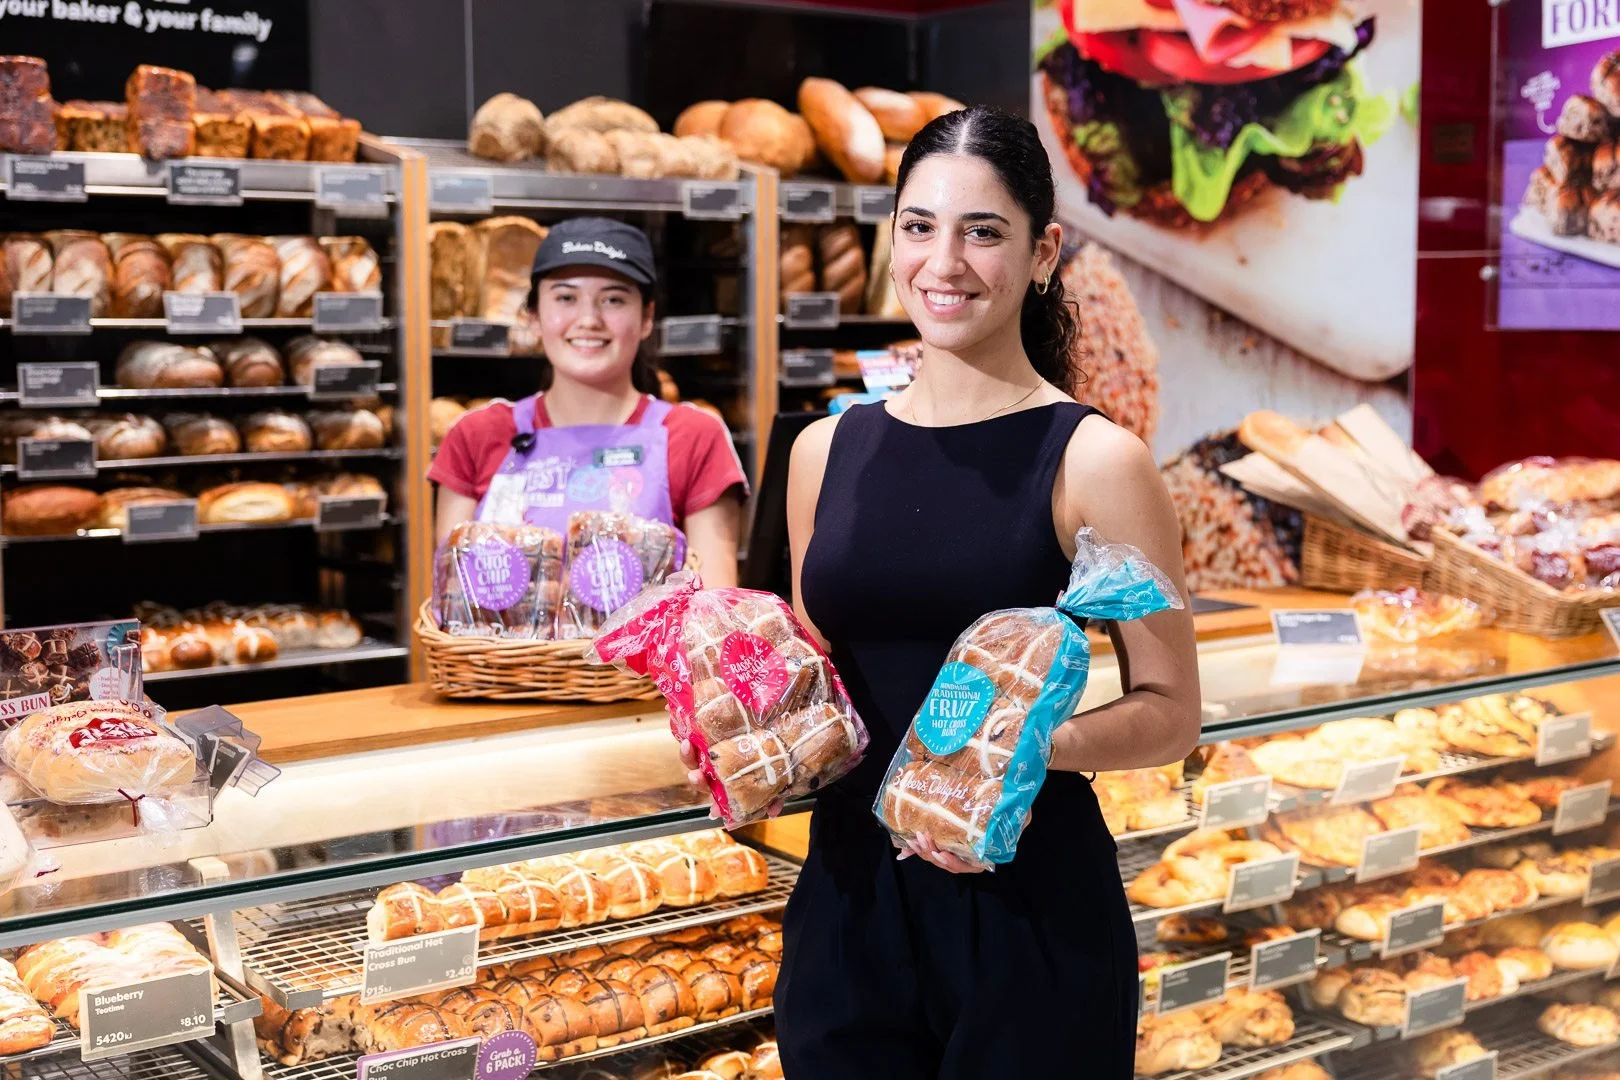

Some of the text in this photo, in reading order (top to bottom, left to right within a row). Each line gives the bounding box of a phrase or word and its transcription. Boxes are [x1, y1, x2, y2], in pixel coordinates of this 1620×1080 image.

[52, 0, 121, 23] baker
[123, 1, 143, 28] &
[145, 9, 199, 33] your
[200, 8, 272, 42] family
[1552, 0, 1620, 34] FOR
[477, 568, 510, 586] CHIP
[931, 688, 981, 700] TRADITIONAL
[929, 698, 979, 718] FRUIT
[932, 719, 948, 729] HOT
[368, 937, 444, 960] Traditional Hot
[367, 954, 416, 972] Cross Bun
[445, 966, 473, 979] $2.40
[94, 990, 144, 1006] Blueberry
[95, 1004, 125, 1015] Teatime
[180, 1014, 206, 1027] $8.10
[368, 1047, 468, 1074] Choc Chip Hot Cross
[486, 1053, 526, 1074] 6 PACK!
[490, 1048, 512, 1061] Grab
